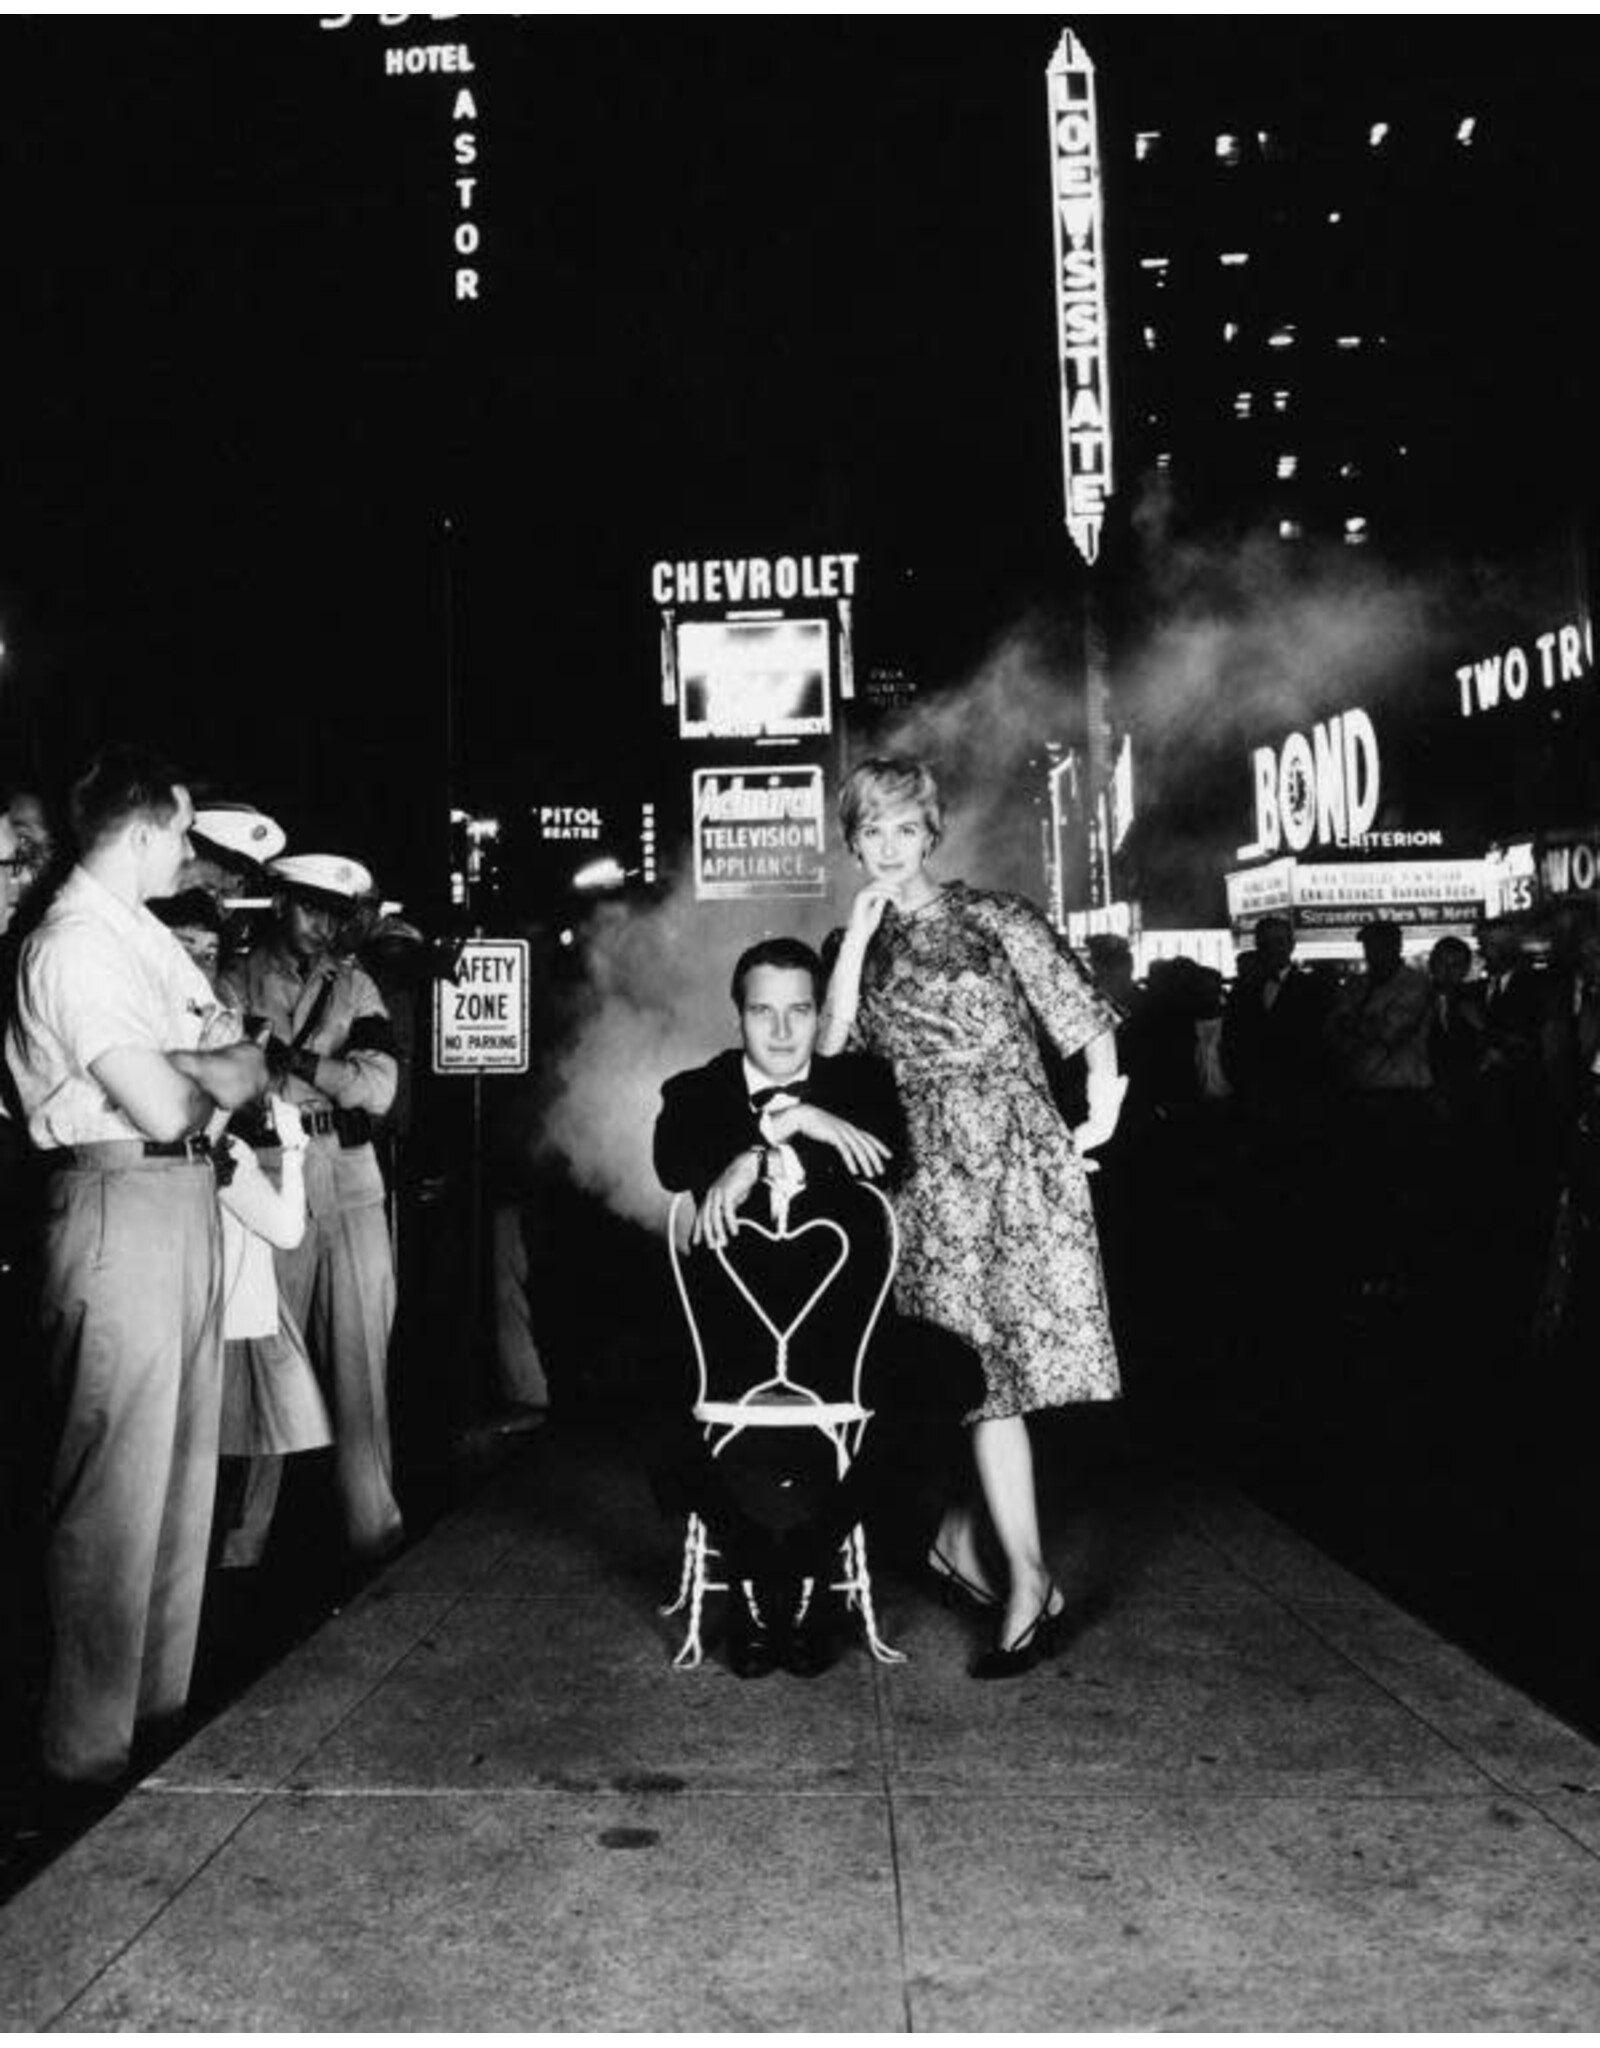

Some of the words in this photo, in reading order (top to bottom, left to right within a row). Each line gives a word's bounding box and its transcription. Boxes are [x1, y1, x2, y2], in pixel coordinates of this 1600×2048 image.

[385, 44, 475, 75] HOTEL
[453, 88, 479, 299] ASTOR
[1065, 302, 1105, 513] STATE
[652, 554, 859, 604] CHEVROLET
[1455, 647, 1529, 717] TWO
[699, 775, 821, 822] Admiral
[1252, 707, 1380, 851] BOND
[531, 806, 603, 826] PITOL
[703, 824, 817, 850] TELEVISION
[1337, 830, 1443, 848] CRITERION
[1541, 844, 1600, 893] WO
[458, 956, 516, 984] AFETY
[455, 993, 509, 1021] ZONE
[445, 1034, 463, 1051] NO
[467, 1034, 518, 1050] PARKING
